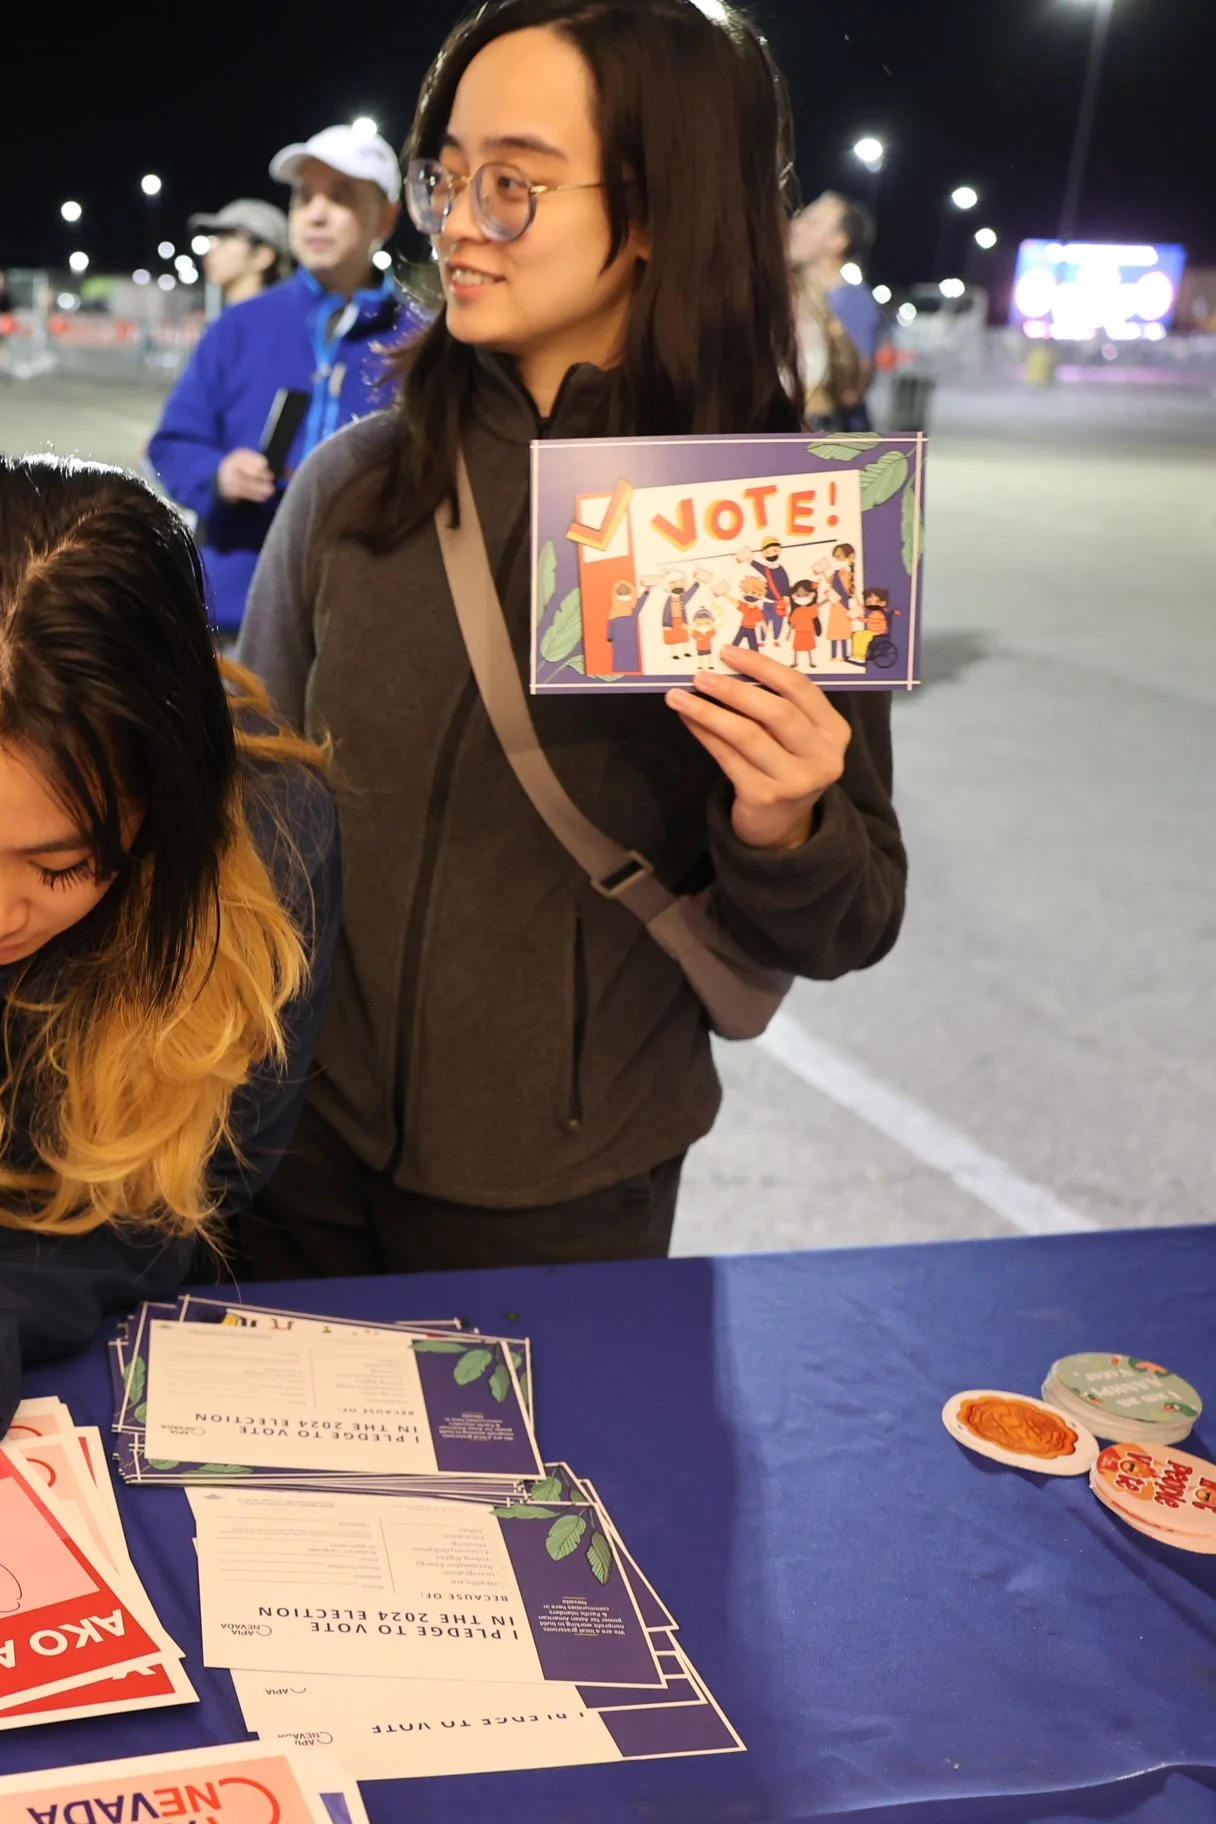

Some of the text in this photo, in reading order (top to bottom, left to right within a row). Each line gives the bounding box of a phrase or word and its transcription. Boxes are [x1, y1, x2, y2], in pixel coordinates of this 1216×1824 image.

[651, 482, 839, 551] VOTE!
[194, 1413, 289, 1428] ELECTION
[298, 1419, 342, 1430] 2024
[239, 1426, 288, 1437] VOTE
[352, 1423, 386, 1432] THE
[297, 1430, 322, 1438] TO
[331, 1432, 404, 1442] PLEDGE
[420, 1592, 508, 1602] BECAUSE OF:
[258, 1607, 514, 1627] IN THE 2024 ELECTION
[28, 1607, 128, 1657] AKO
[220, 1622, 260, 1631] NEVADA
[310, 1622, 519, 1640] I PLEDGE TO VOTE
[231, 1629, 254, 1637] APIA
[27, 1782, 221, 1824] NEVADA
